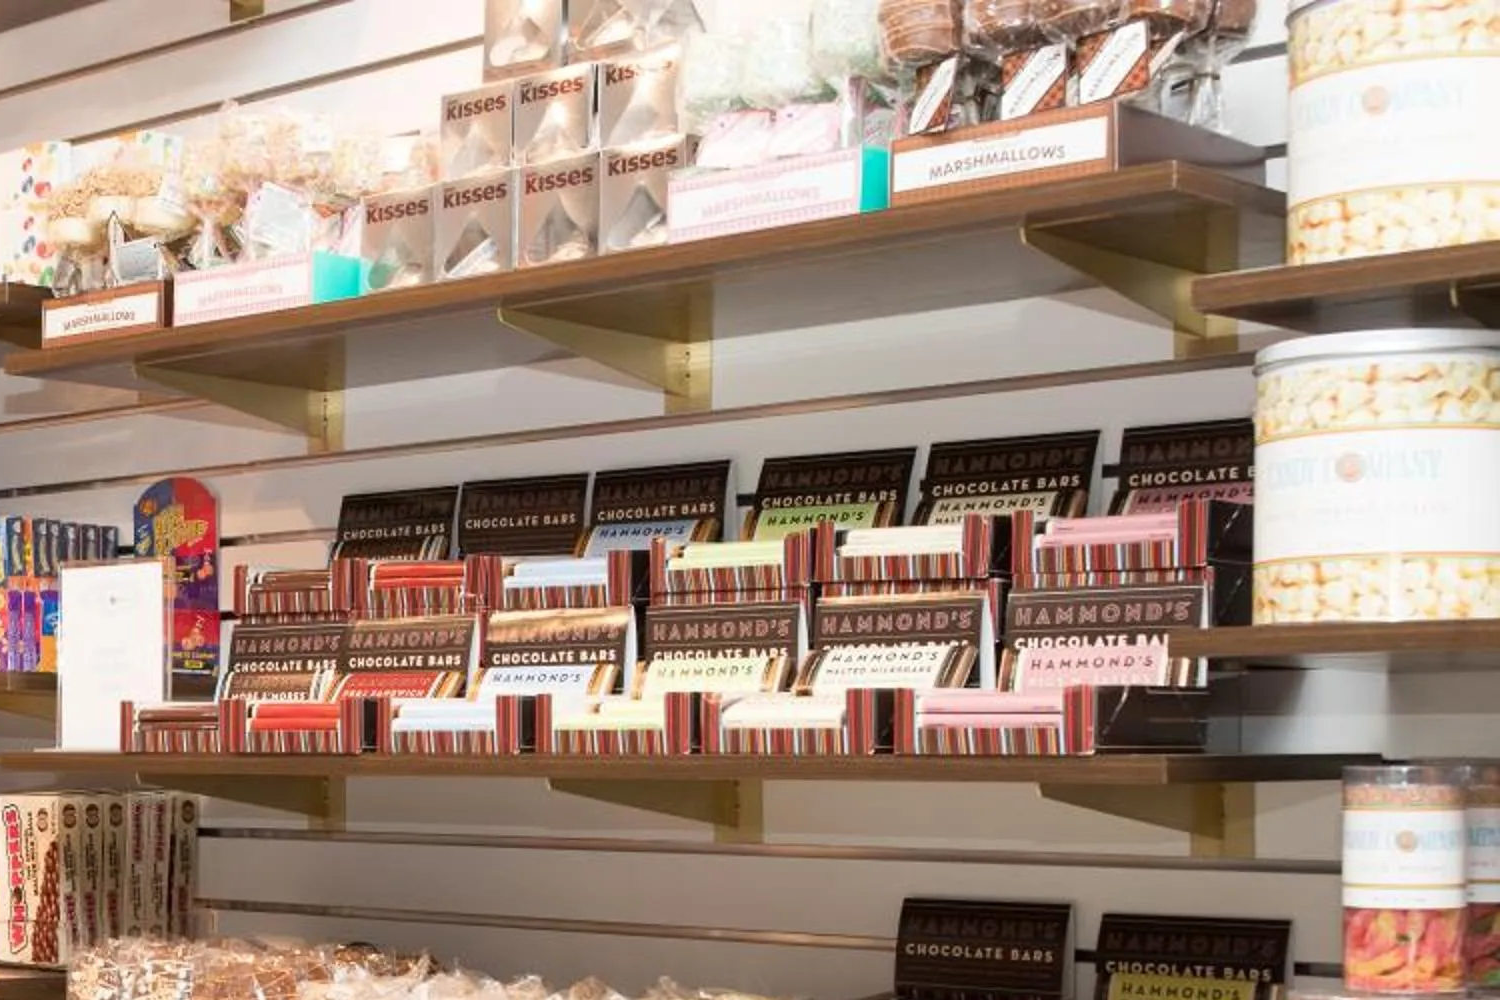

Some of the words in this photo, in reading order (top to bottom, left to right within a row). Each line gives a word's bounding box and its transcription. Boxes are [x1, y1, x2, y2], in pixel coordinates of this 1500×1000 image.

[928, 144, 1066, 181] MARSHMALLOWS
[1129, 467, 1238, 487] CHOCOLATE
[932, 480, 1030, 497] CHOCOLATE
[1037, 476, 1080, 489] BARS
[762, 493, 854, 509] CHOCOLATE
[858, 490, 897, 502] BARS
[940, 496, 1046, 513] HAMMOND'S
[597, 506, 676, 521] CHOCOLATE
[681, 503, 717, 514] BARS
[767, 510, 863, 527] HAMMOND'S
[466, 517, 538, 529] CHOCOLATE
[544, 514, 576, 525] BARS
[344, 526, 409, 541] CHOCOLATE
[416, 523, 445, 535] BARS
[599, 526, 685, 538] HAMMOND'S
[821, 609, 973, 633] HAMMOND'S
[1014, 602, 1192, 625] HAMMOND'S
[350, 629, 466, 648] HAMMOND'S
[653, 620, 791, 641] HAMMOND'S
[235, 636, 340, 653] HAMMOND'S
[1014, 634, 1128, 649] CHOCOLATE
[349, 656, 423, 668] CHOCOLATE
[428, 655, 461, 666] BARS
[492, 650, 574, 664] CHOCOLATE
[580, 649, 617, 662] BARS
[653, 649, 742, 661] CHOCOLATE
[747, 647, 788, 659] BARS
[832, 651, 939, 662] HAMMOND'S
[235, 661, 303, 673] CHOCOLATE
[308, 660, 337, 670] BARS
[657, 664, 753, 677] HAMMOND'S
[1031, 656, 1154, 670] HAMMOND'S
[492, 672, 581, 683] HAMMOND'S
[906, 943, 1003, 961] CHOCOLATE
[1011, 949, 1054, 963] BARS
[1105, 961, 1217, 977] CHOCOLATE
[1224, 966, 1273, 981] BARS
